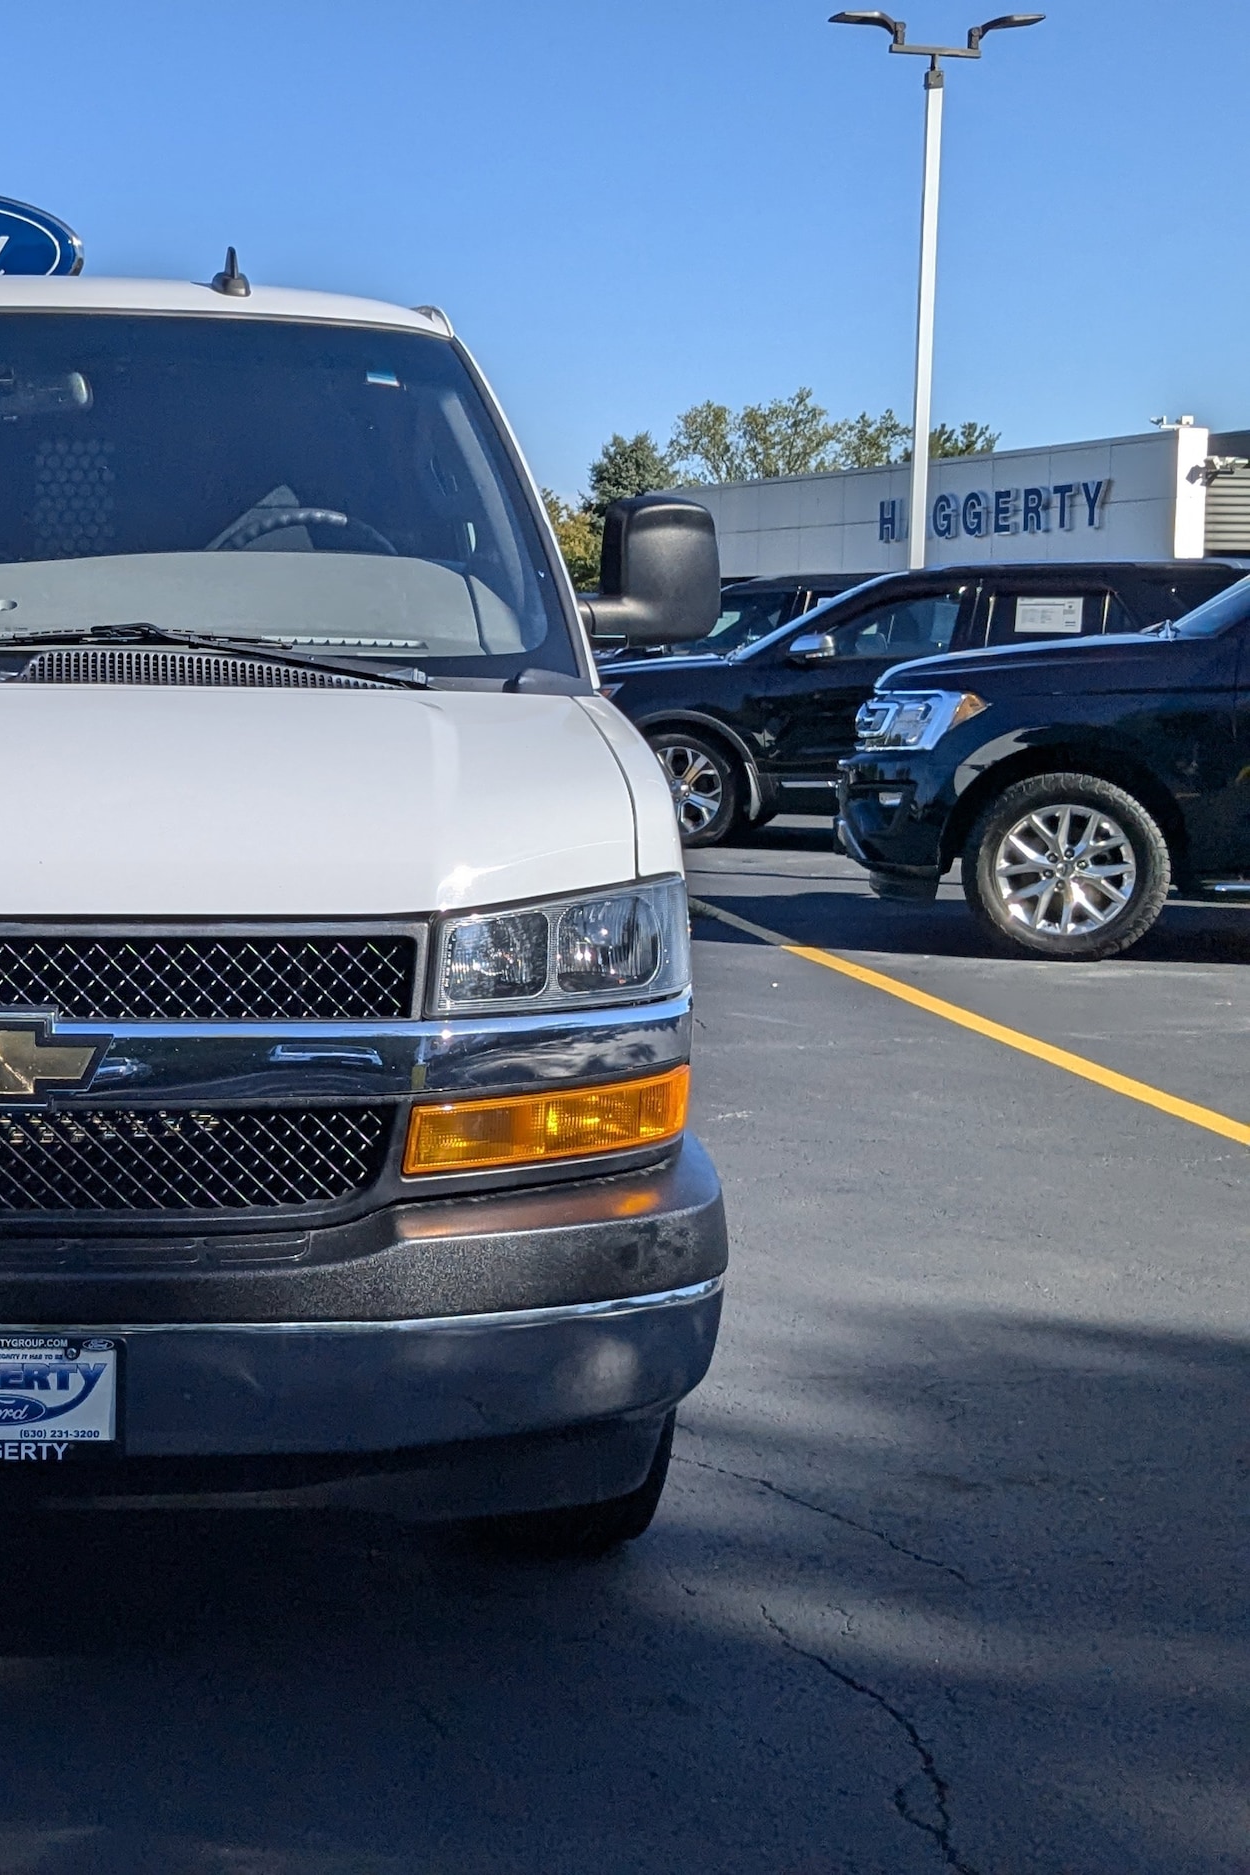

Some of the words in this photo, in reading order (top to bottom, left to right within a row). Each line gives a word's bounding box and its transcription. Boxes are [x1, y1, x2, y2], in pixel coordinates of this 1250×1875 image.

[878, 480, 1108, 542] HGGERTY
[19, 1429, 47, 1439] (630)
[49, 1429, 100, 1438] 231-3200
